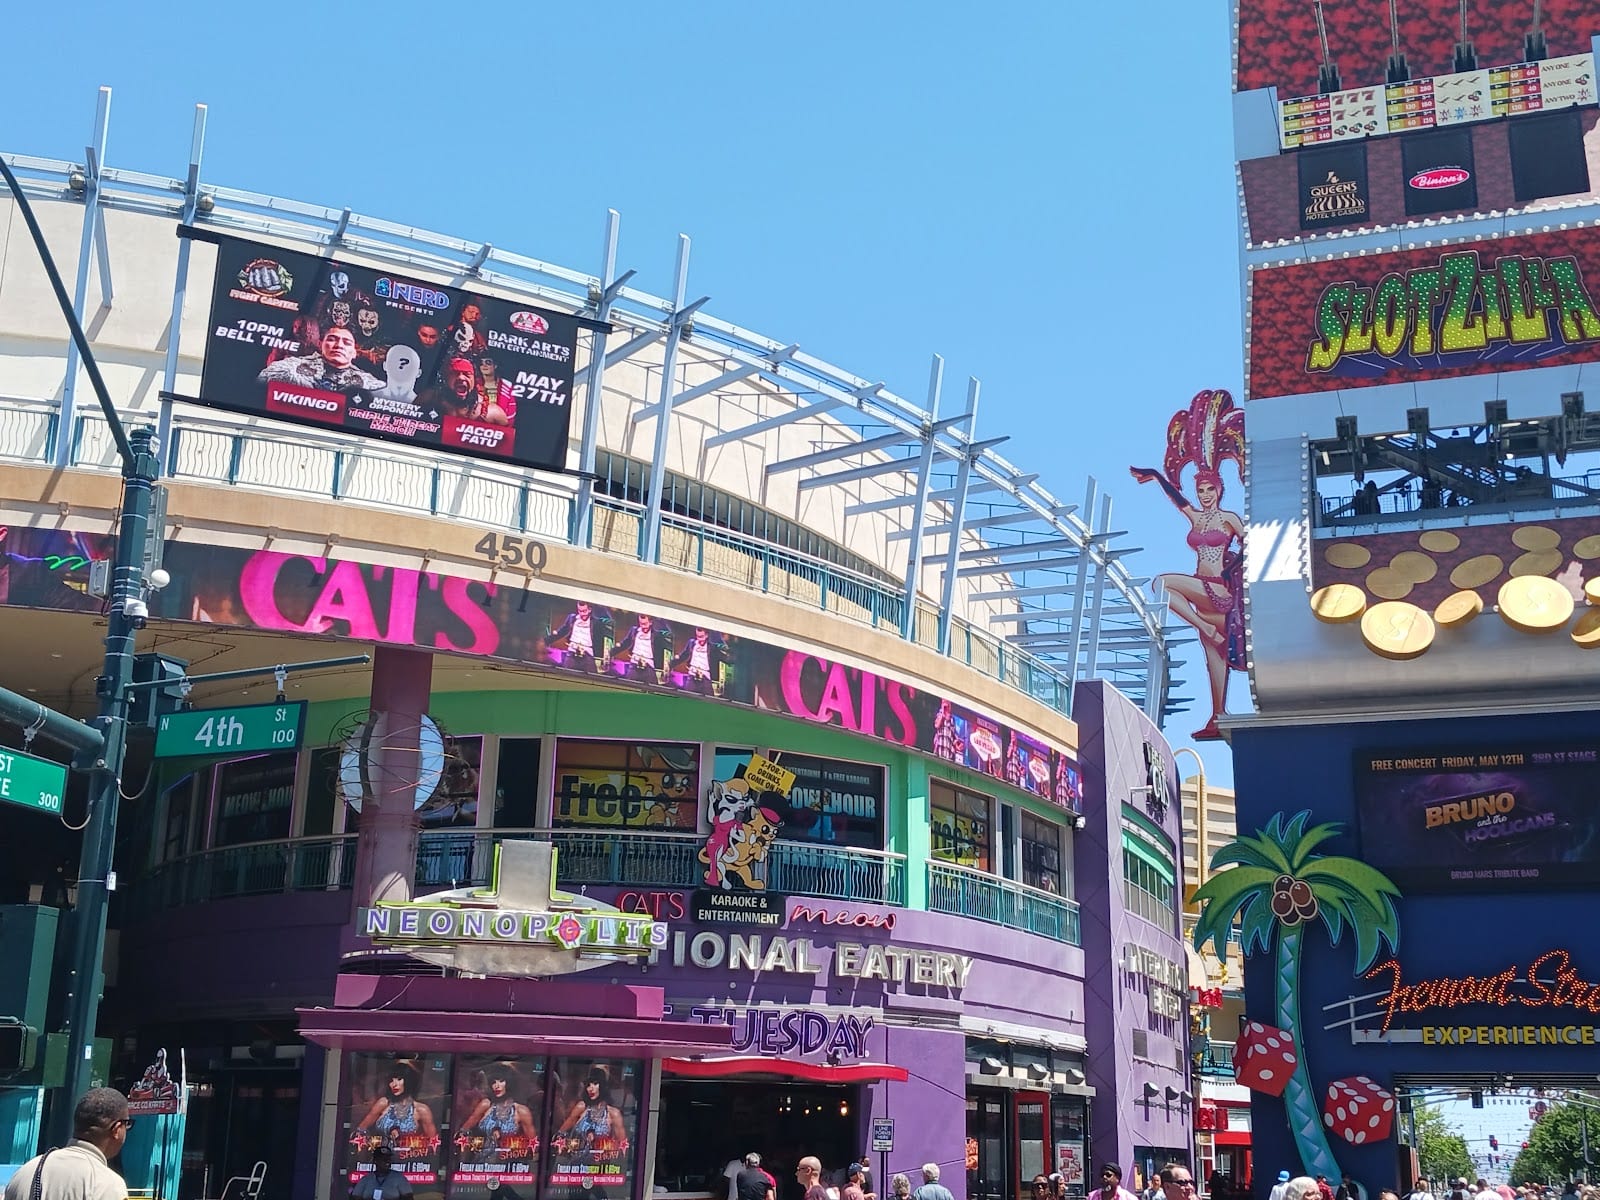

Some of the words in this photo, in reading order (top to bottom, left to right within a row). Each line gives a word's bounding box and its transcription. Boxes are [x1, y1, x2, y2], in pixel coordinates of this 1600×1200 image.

[1415, 174, 1464, 187] Binion's
[1310, 183, 1357, 197] QUEENS
[1305, 213, 1330, 221] HOTEL
[1338, 207, 1365, 218] CASINO
[392, 281, 450, 310] NERD
[385, 300, 434, 316] PRESENTS
[237, 319, 284, 337] 10PM
[215, 326, 255, 343] BELL
[260, 335, 300, 352] TIME
[488, 330, 528, 348] DARK
[533, 337, 570, 356] ARTS
[488, 339, 570, 363] ENTERTAINMENT
[516, 371, 564, 392] MAY
[272, 390, 338, 412] VIKINGO
[373, 397, 422, 412] MYSTERY
[510, 385, 566, 406] 27TH
[369, 403, 424, 418] OPPONENT
[455, 423, 505, 441] JACOB
[461, 434, 498, 448] FATU
[475, 532, 547, 570] 450
[161, 717, 170, 731] N
[194, 715, 244, 748] 4th
[275, 708, 287, 722] St
[272, 728, 295, 743] 100
[761, 760, 786, 777] 2-FOR-1
[1371, 760, 1393, 771] FREE
[1395, 758, 1437, 769] CONCERT
[1479, 755, 1498, 767] MAY
[1501, 754, 1524, 765] 12TH
[747, 772, 764, 787] COME
[38, 791, 59, 809] 300
[559, 775, 641, 819] Free
[1425, 792, 1515, 828] BRUNO
[1464, 811, 1556, 843] HOOLIGANS
[1477, 816, 1491, 827] and
[1492, 814, 1508, 825] the
[1451, 869, 1474, 880] BRUNO
[1474, 869, 1493, 879] MARS
[1494, 869, 1521, 879] TRIBUTE
[1521, 868, 1539, 878] BAND
[616, 892, 684, 920] CAT'S
[711, 894, 758, 909] KARAOKE
[760, 897, 768, 909] &
[790, 902, 897, 931] meow
[698, 909, 780, 925] ENTERTAINMENT
[836, 942, 975, 989] EATERY
[1365, 958, 1517, 1038] Fremont
[1422, 1025, 1596, 1045] EXPERIENCE
[399, 1148, 429, 1159] SHOW
[500, 1149, 528, 1160] SHOW
